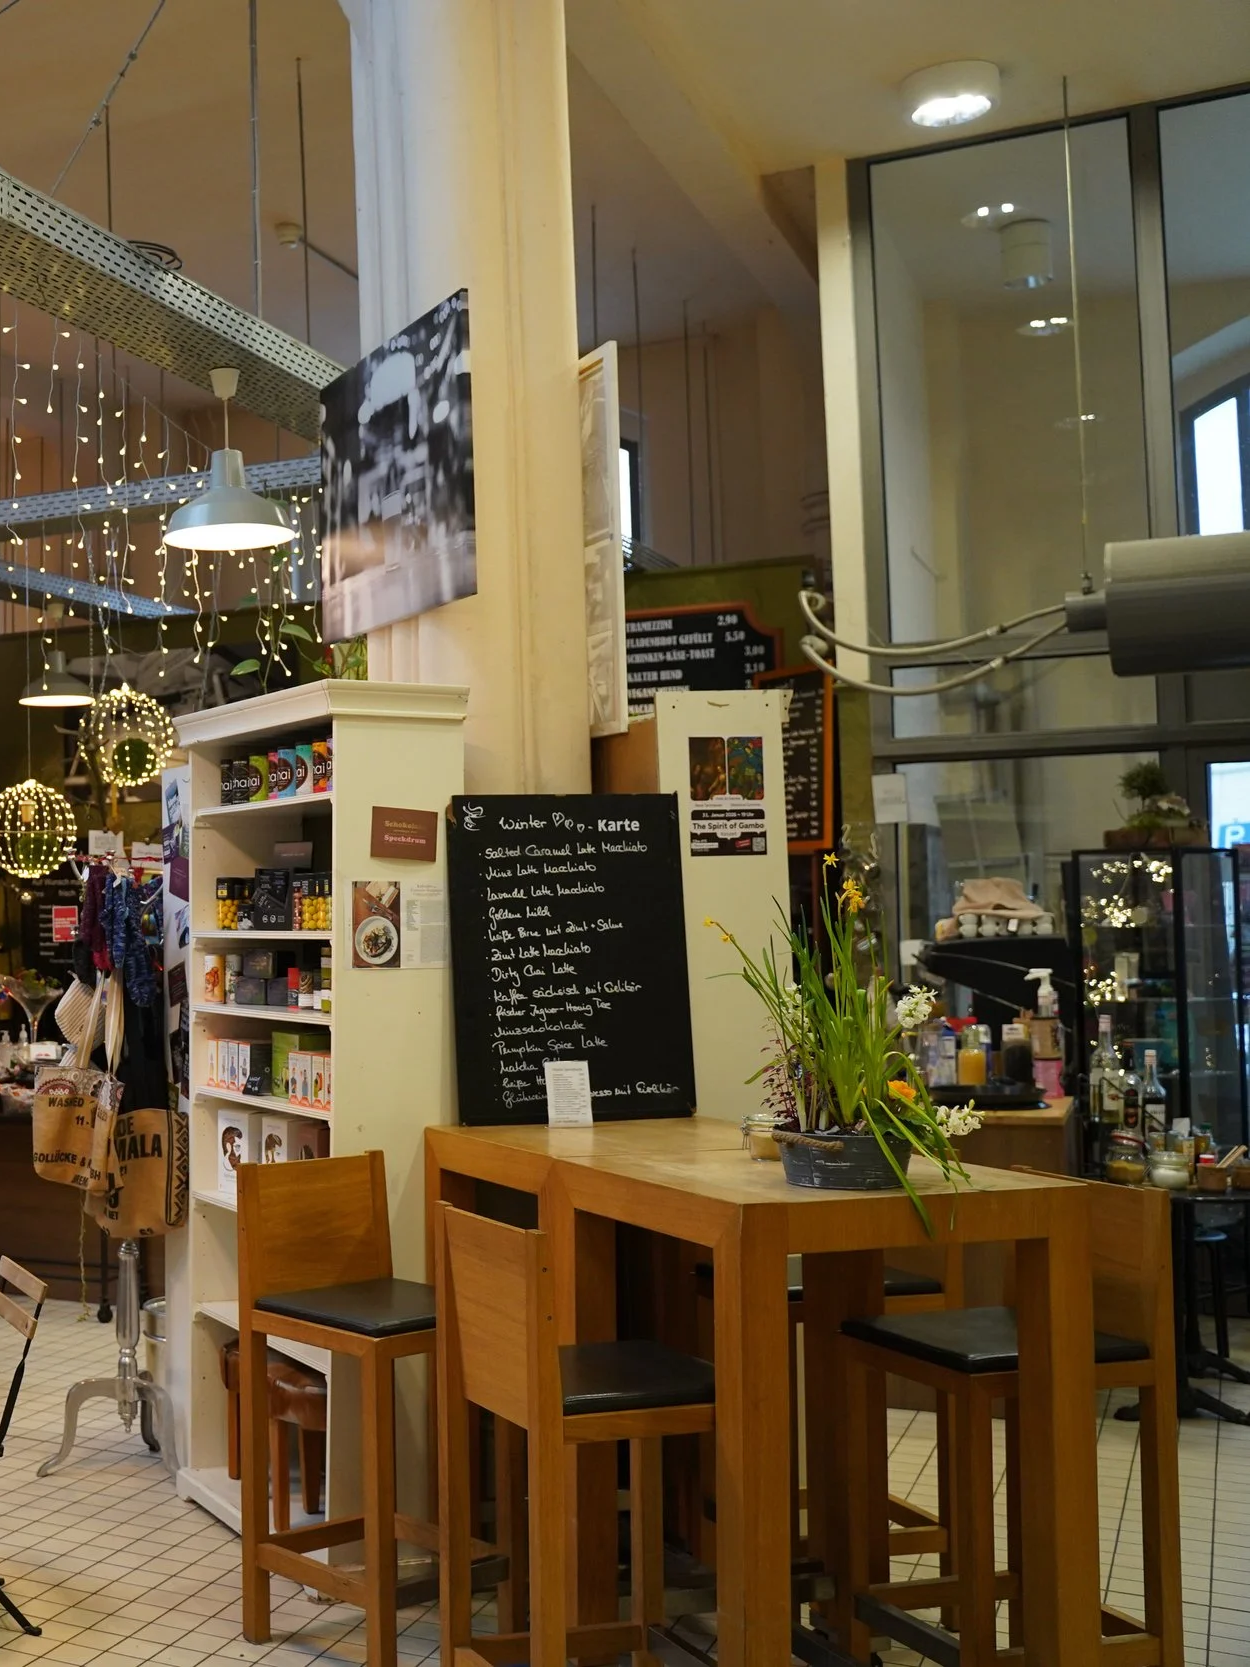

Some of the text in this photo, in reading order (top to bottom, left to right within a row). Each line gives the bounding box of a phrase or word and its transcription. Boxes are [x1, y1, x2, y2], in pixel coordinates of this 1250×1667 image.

[499, 814, 548, 830] Winter
[597, 819, 640, 832] Karte
[692, 822, 707, 830] The
[707, 822, 728, 831] Spirit
[383, 833, 427, 846] Speckdrum
[484, 840, 648, 860] Salted Caramel Latte Macchiato
[516, 863, 539, 876] Latte
[543, 861, 597, 874] Macchiato
[530, 885, 554, 897] Latte
[556, 881, 605, 896] Macchiato
[545, 924, 562, 936] mit
[518, 946, 541, 959] Latte
[542, 941, 592, 957] Macchiato
[491, 962, 578, 987] Dirty Chai Latte
[593, 997, 612, 1010] Tee
[491, 1034, 608, 1058] Pumpkin Spice Latte
